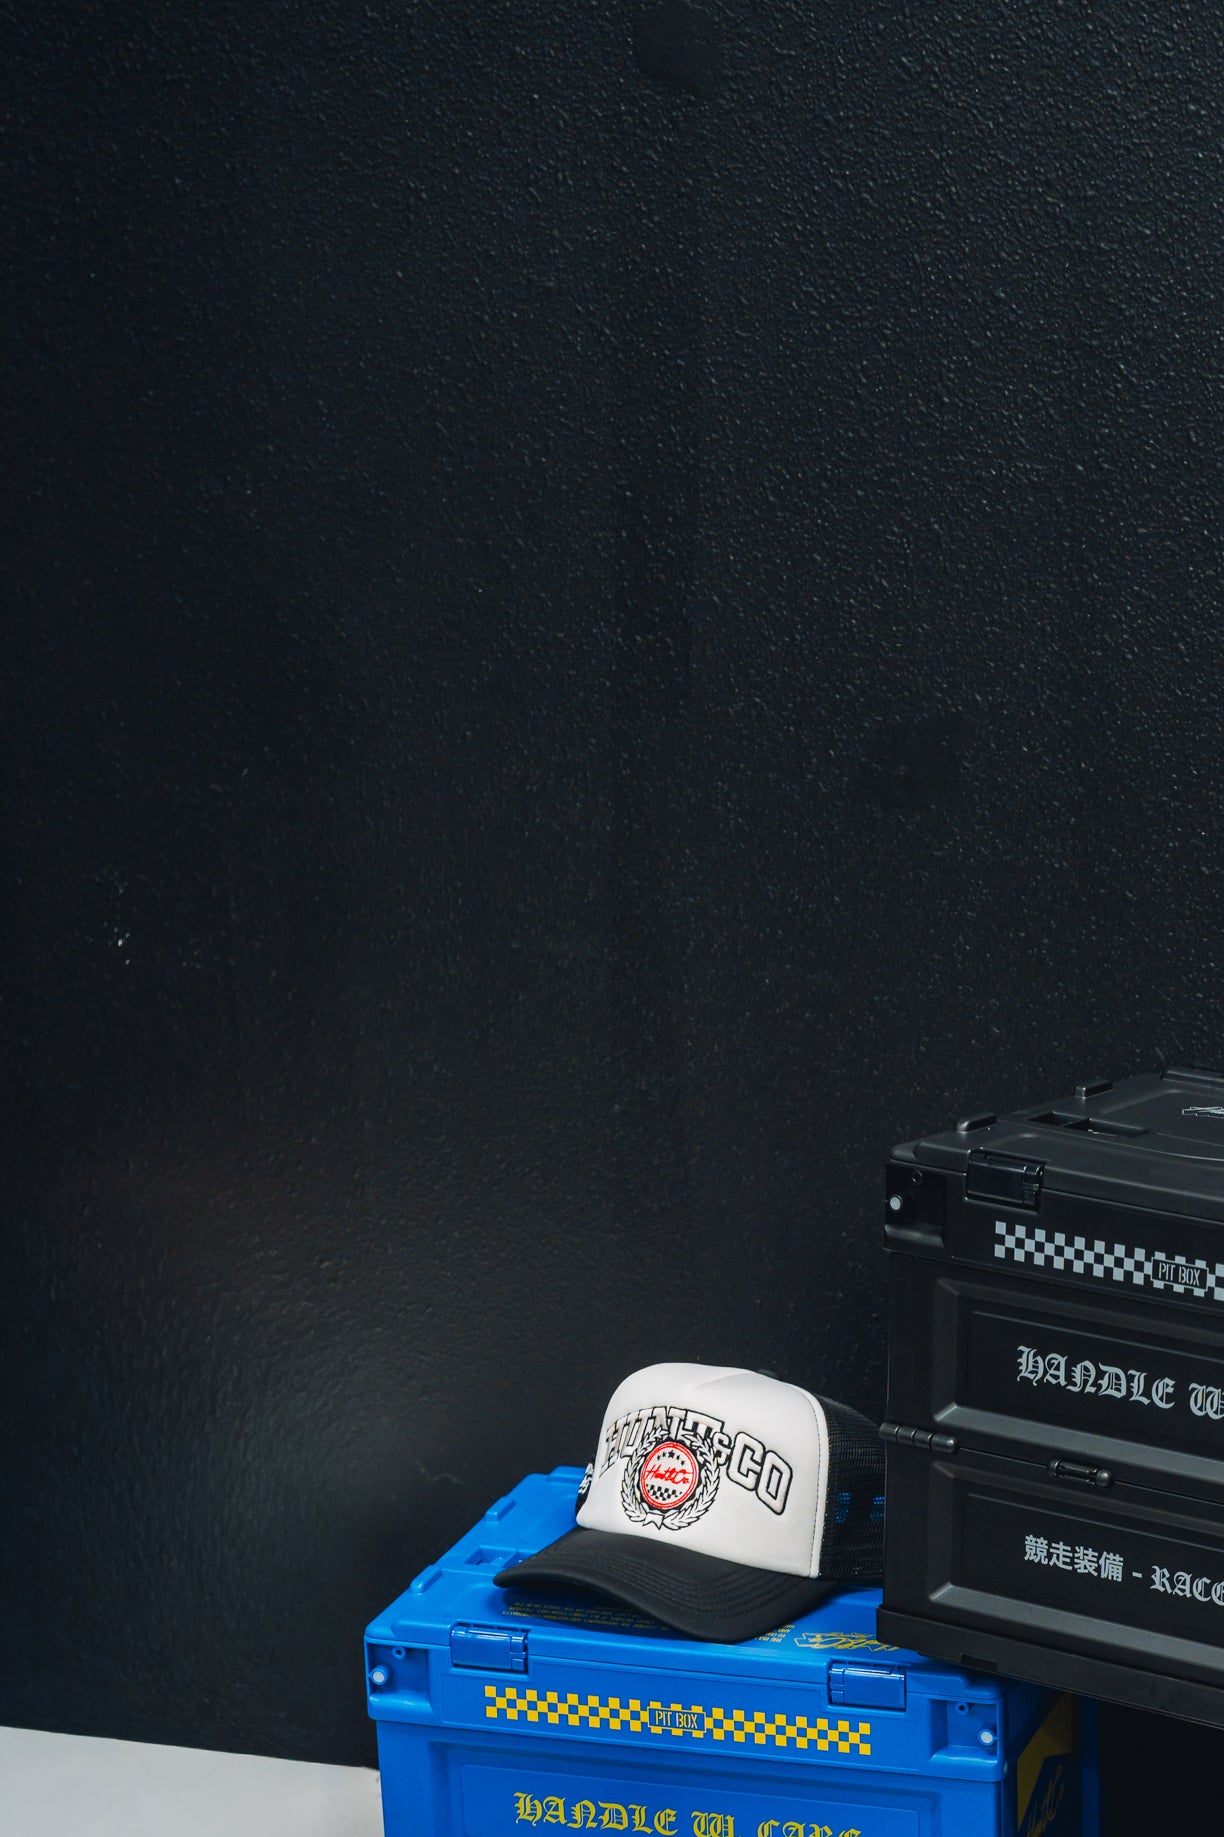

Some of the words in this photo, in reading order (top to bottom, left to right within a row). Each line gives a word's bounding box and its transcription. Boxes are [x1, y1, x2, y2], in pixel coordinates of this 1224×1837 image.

[1159, 1262, 1176, 1281] PIT
[1179, 1265, 1200, 1286] BOX
[1017, 1346, 1176, 1409] HANDLE
[1024, 1535, 1124, 1582] 競走装備
[655, 1710, 672, 1726] PIT
[676, 1712, 698, 1729] BOX
[513, 1791, 678, 1836] HANDLE
